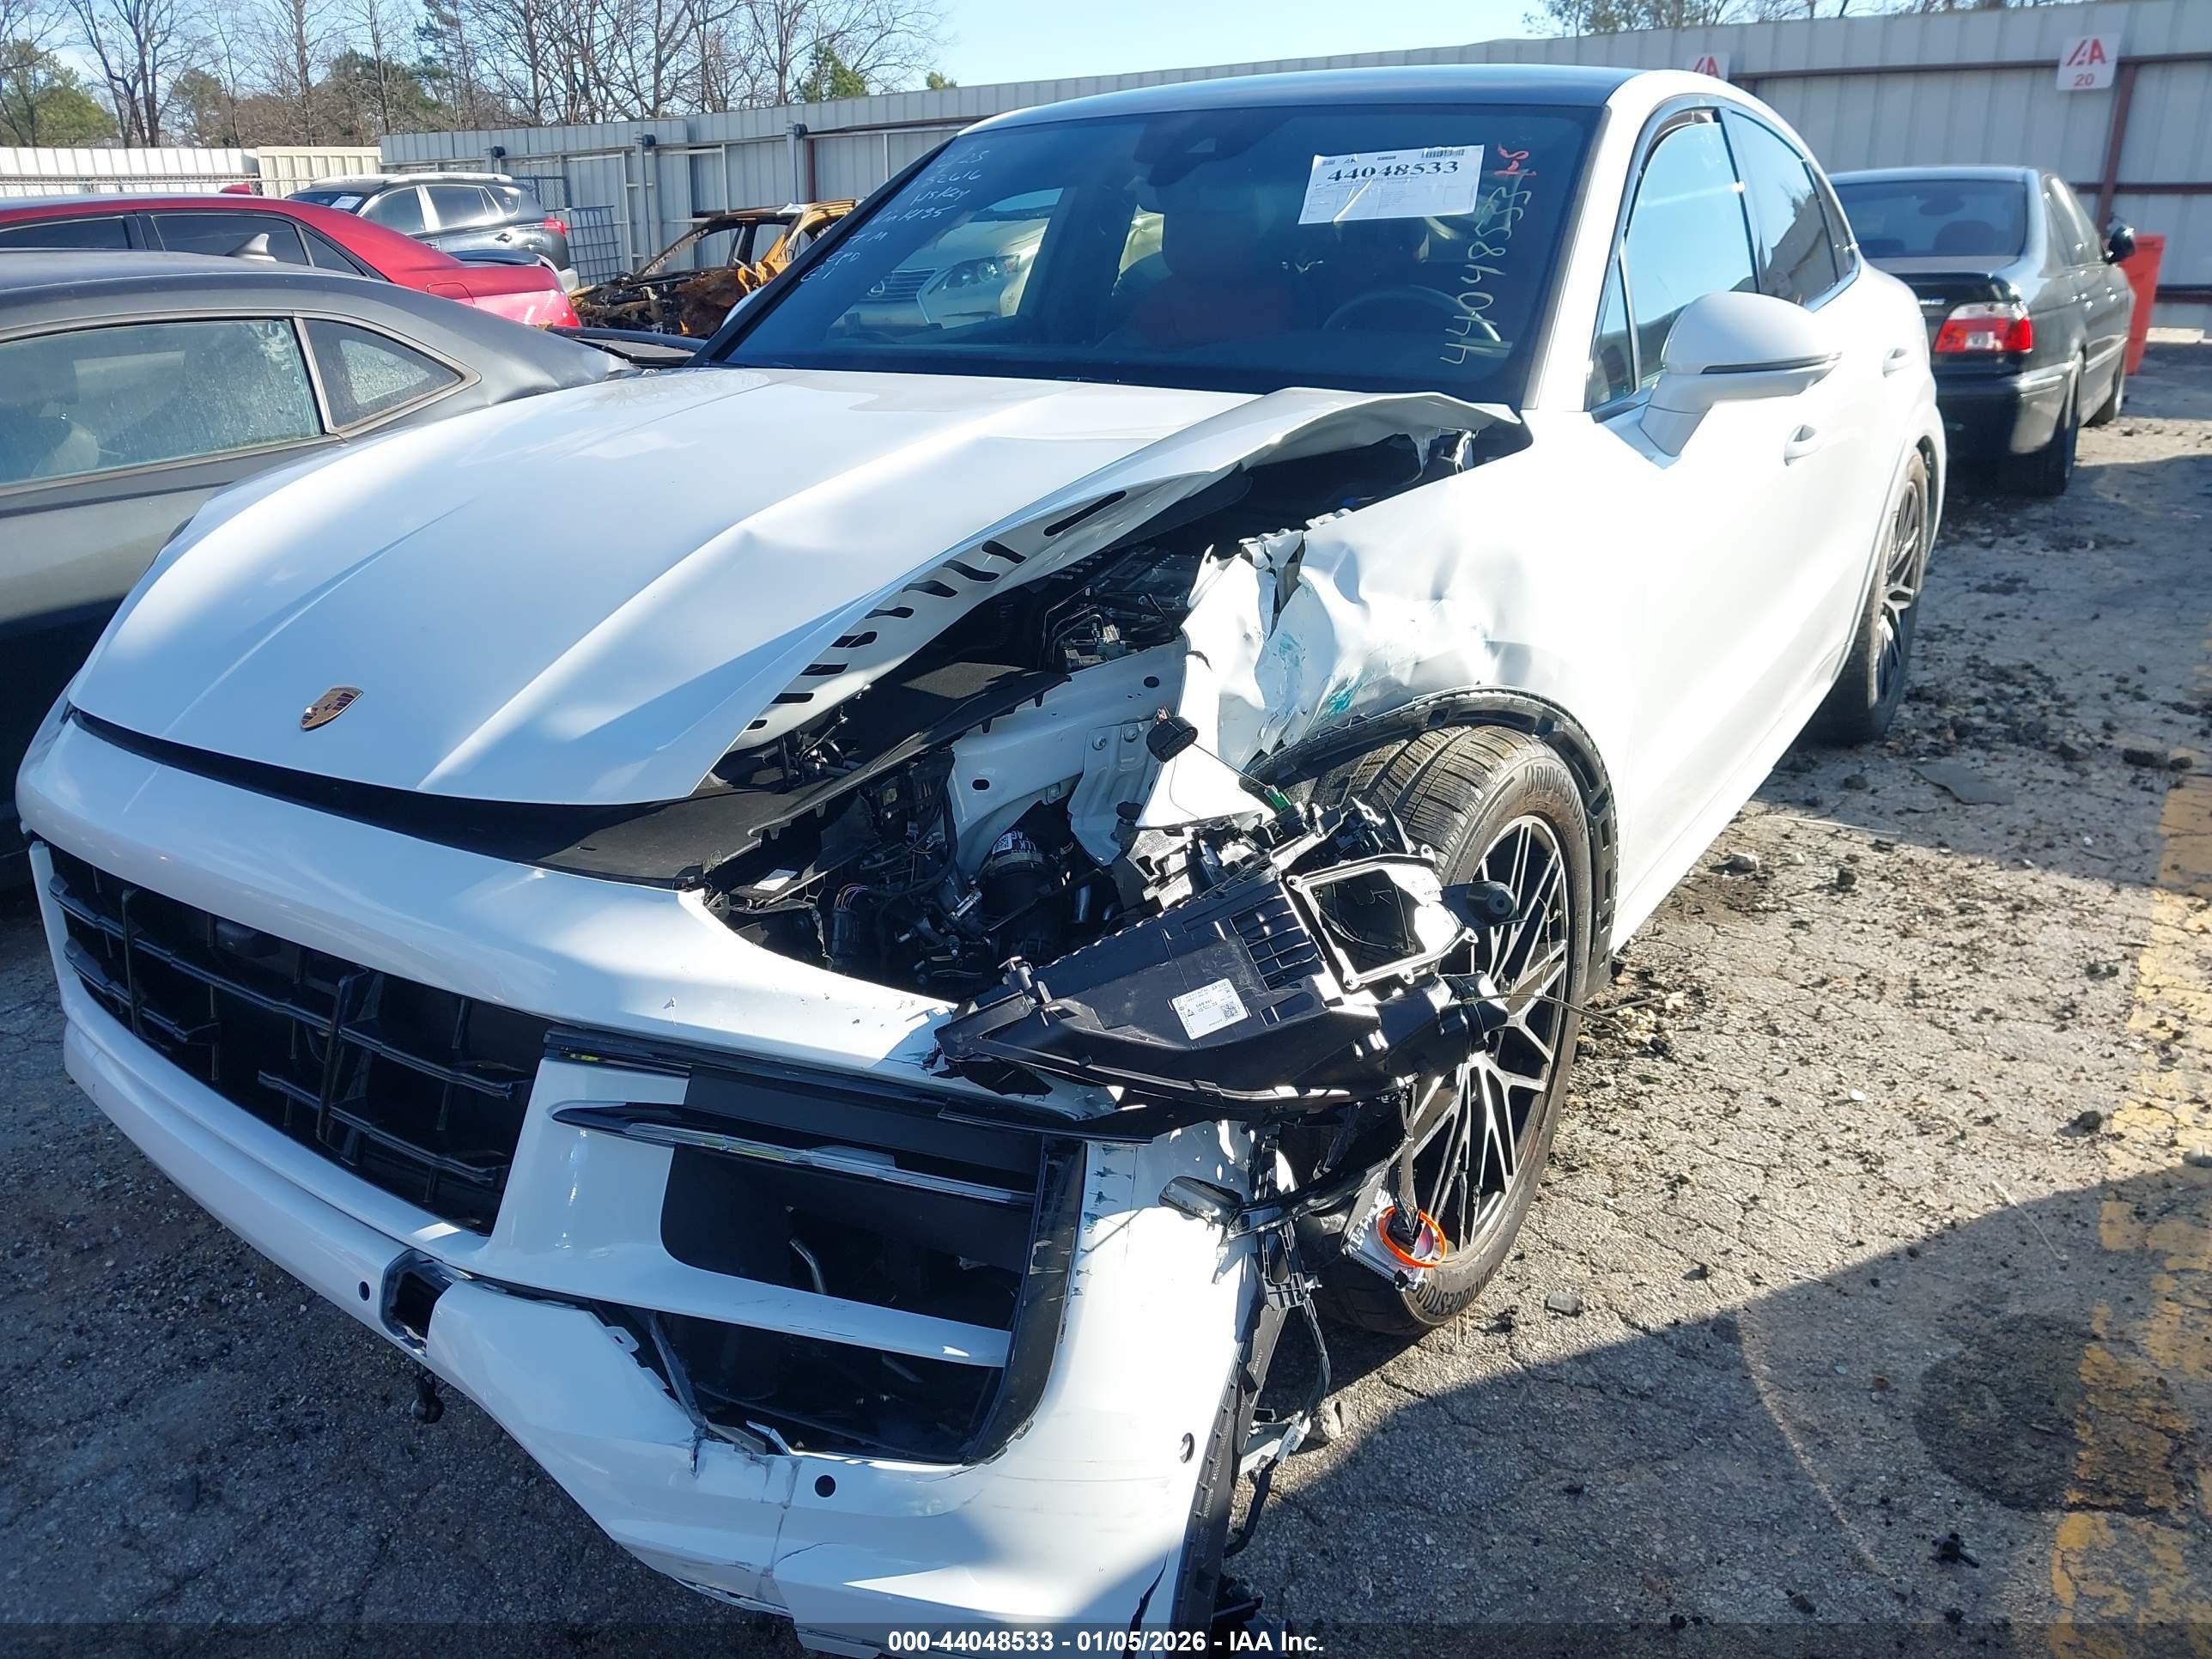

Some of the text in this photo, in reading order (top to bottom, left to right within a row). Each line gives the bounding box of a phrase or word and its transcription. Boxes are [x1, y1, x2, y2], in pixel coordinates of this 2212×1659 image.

[2074, 73, 2094, 87] 20
[1327, 160, 1459, 182] 44048533
[1524, 762, 1588, 842] BRIDGESTONE
